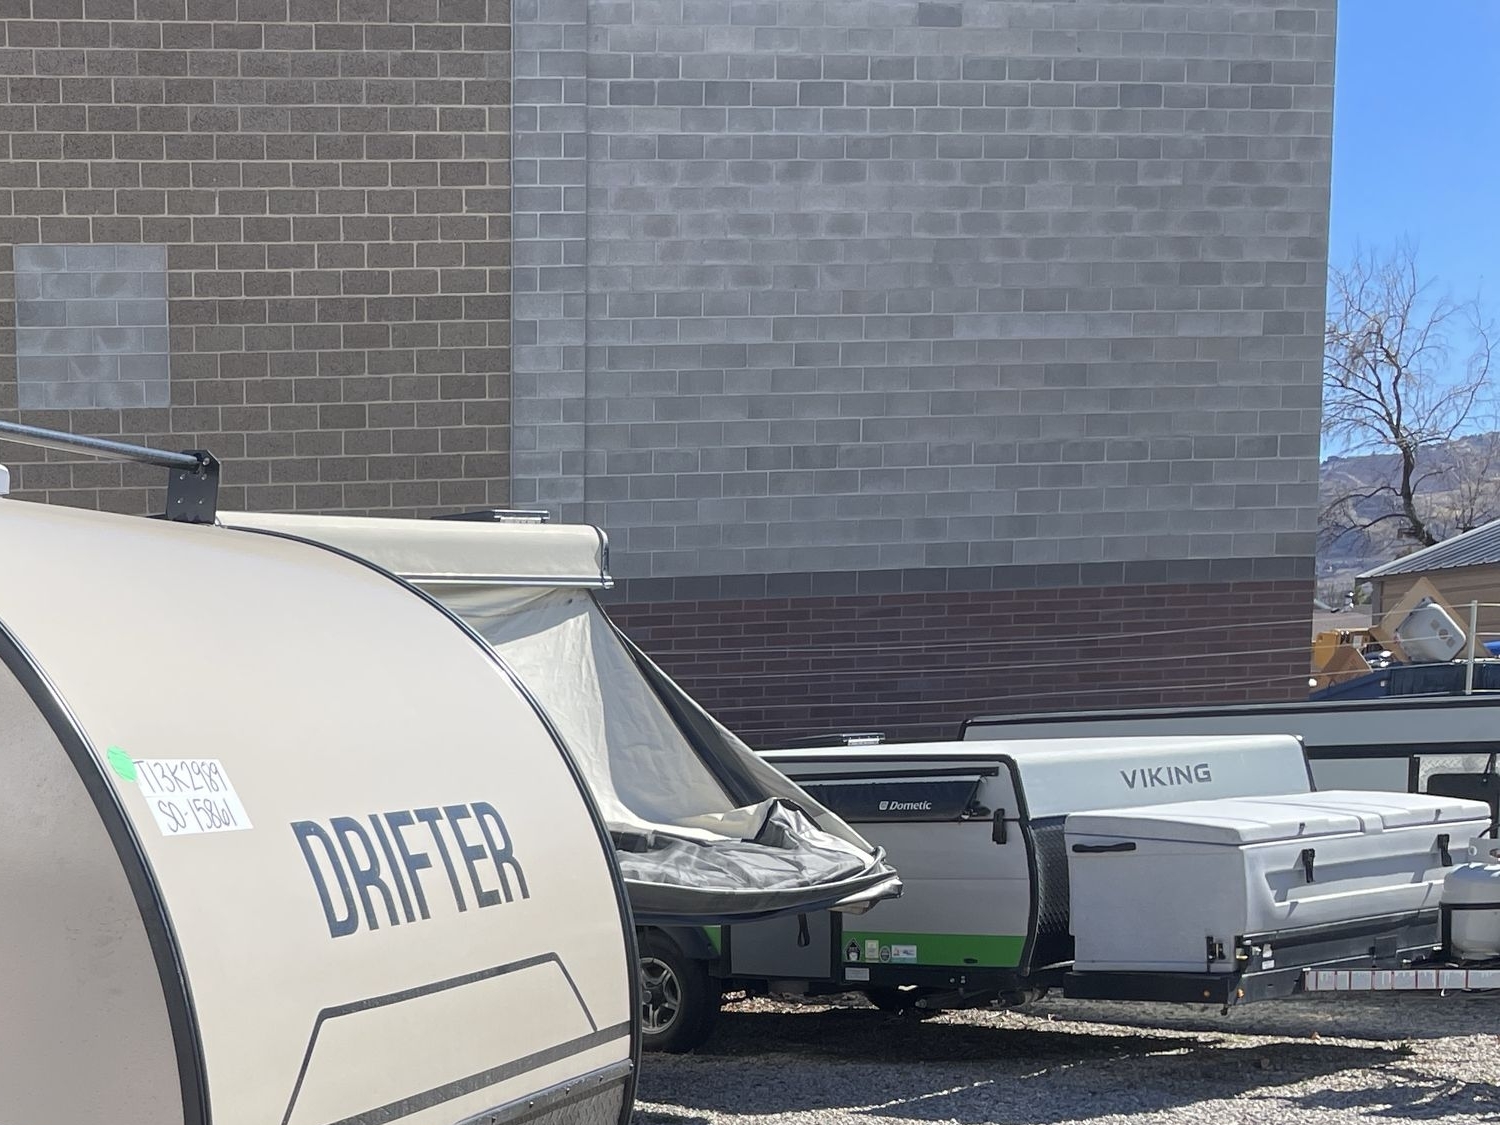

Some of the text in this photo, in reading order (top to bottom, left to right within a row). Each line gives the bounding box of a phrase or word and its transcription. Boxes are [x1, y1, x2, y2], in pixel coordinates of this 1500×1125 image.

[1120, 763, 1212, 789] VIKING
[889, 800, 932, 811] Dometic
[290, 801, 530, 938] DRIFTER
